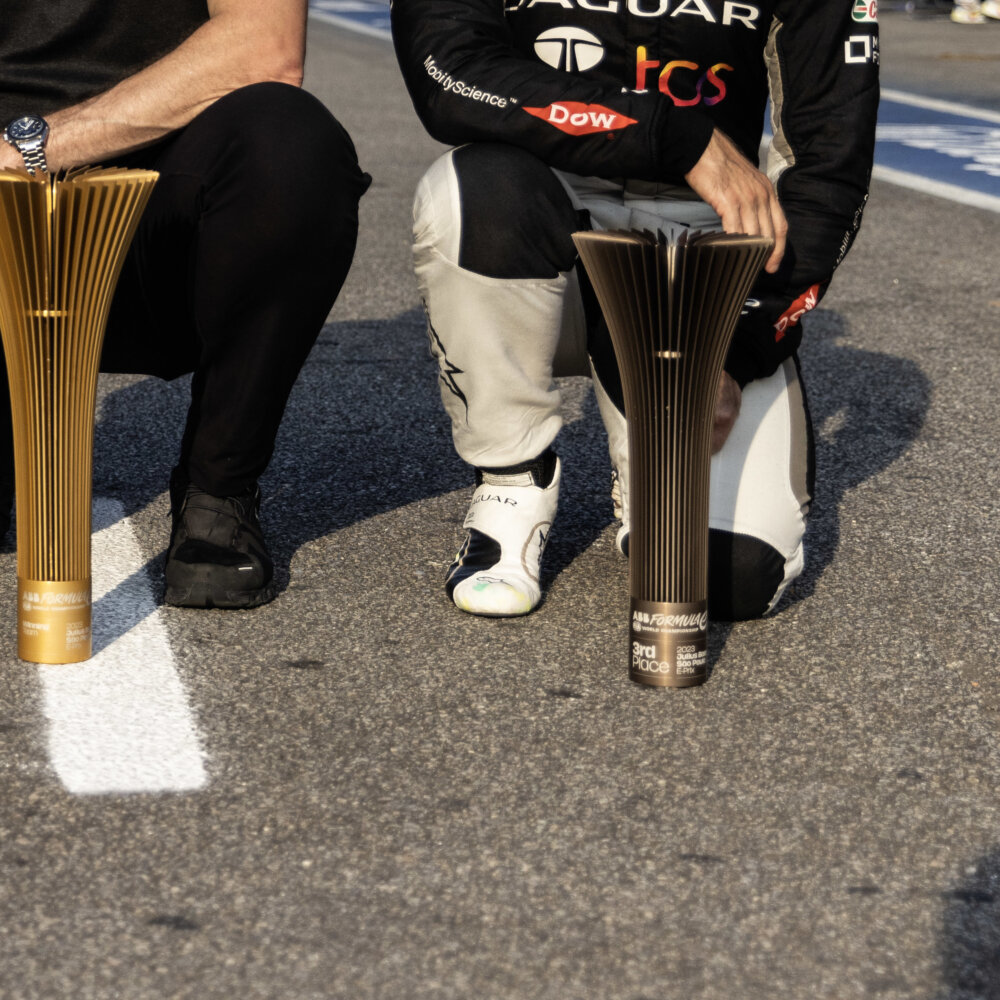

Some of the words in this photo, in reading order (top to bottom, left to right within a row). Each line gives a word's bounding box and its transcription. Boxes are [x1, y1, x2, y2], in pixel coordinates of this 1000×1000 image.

[650, 612, 701, 628] FORMULA
[632, 641, 656, 659] 3rd
[632, 655, 670, 674] Place
